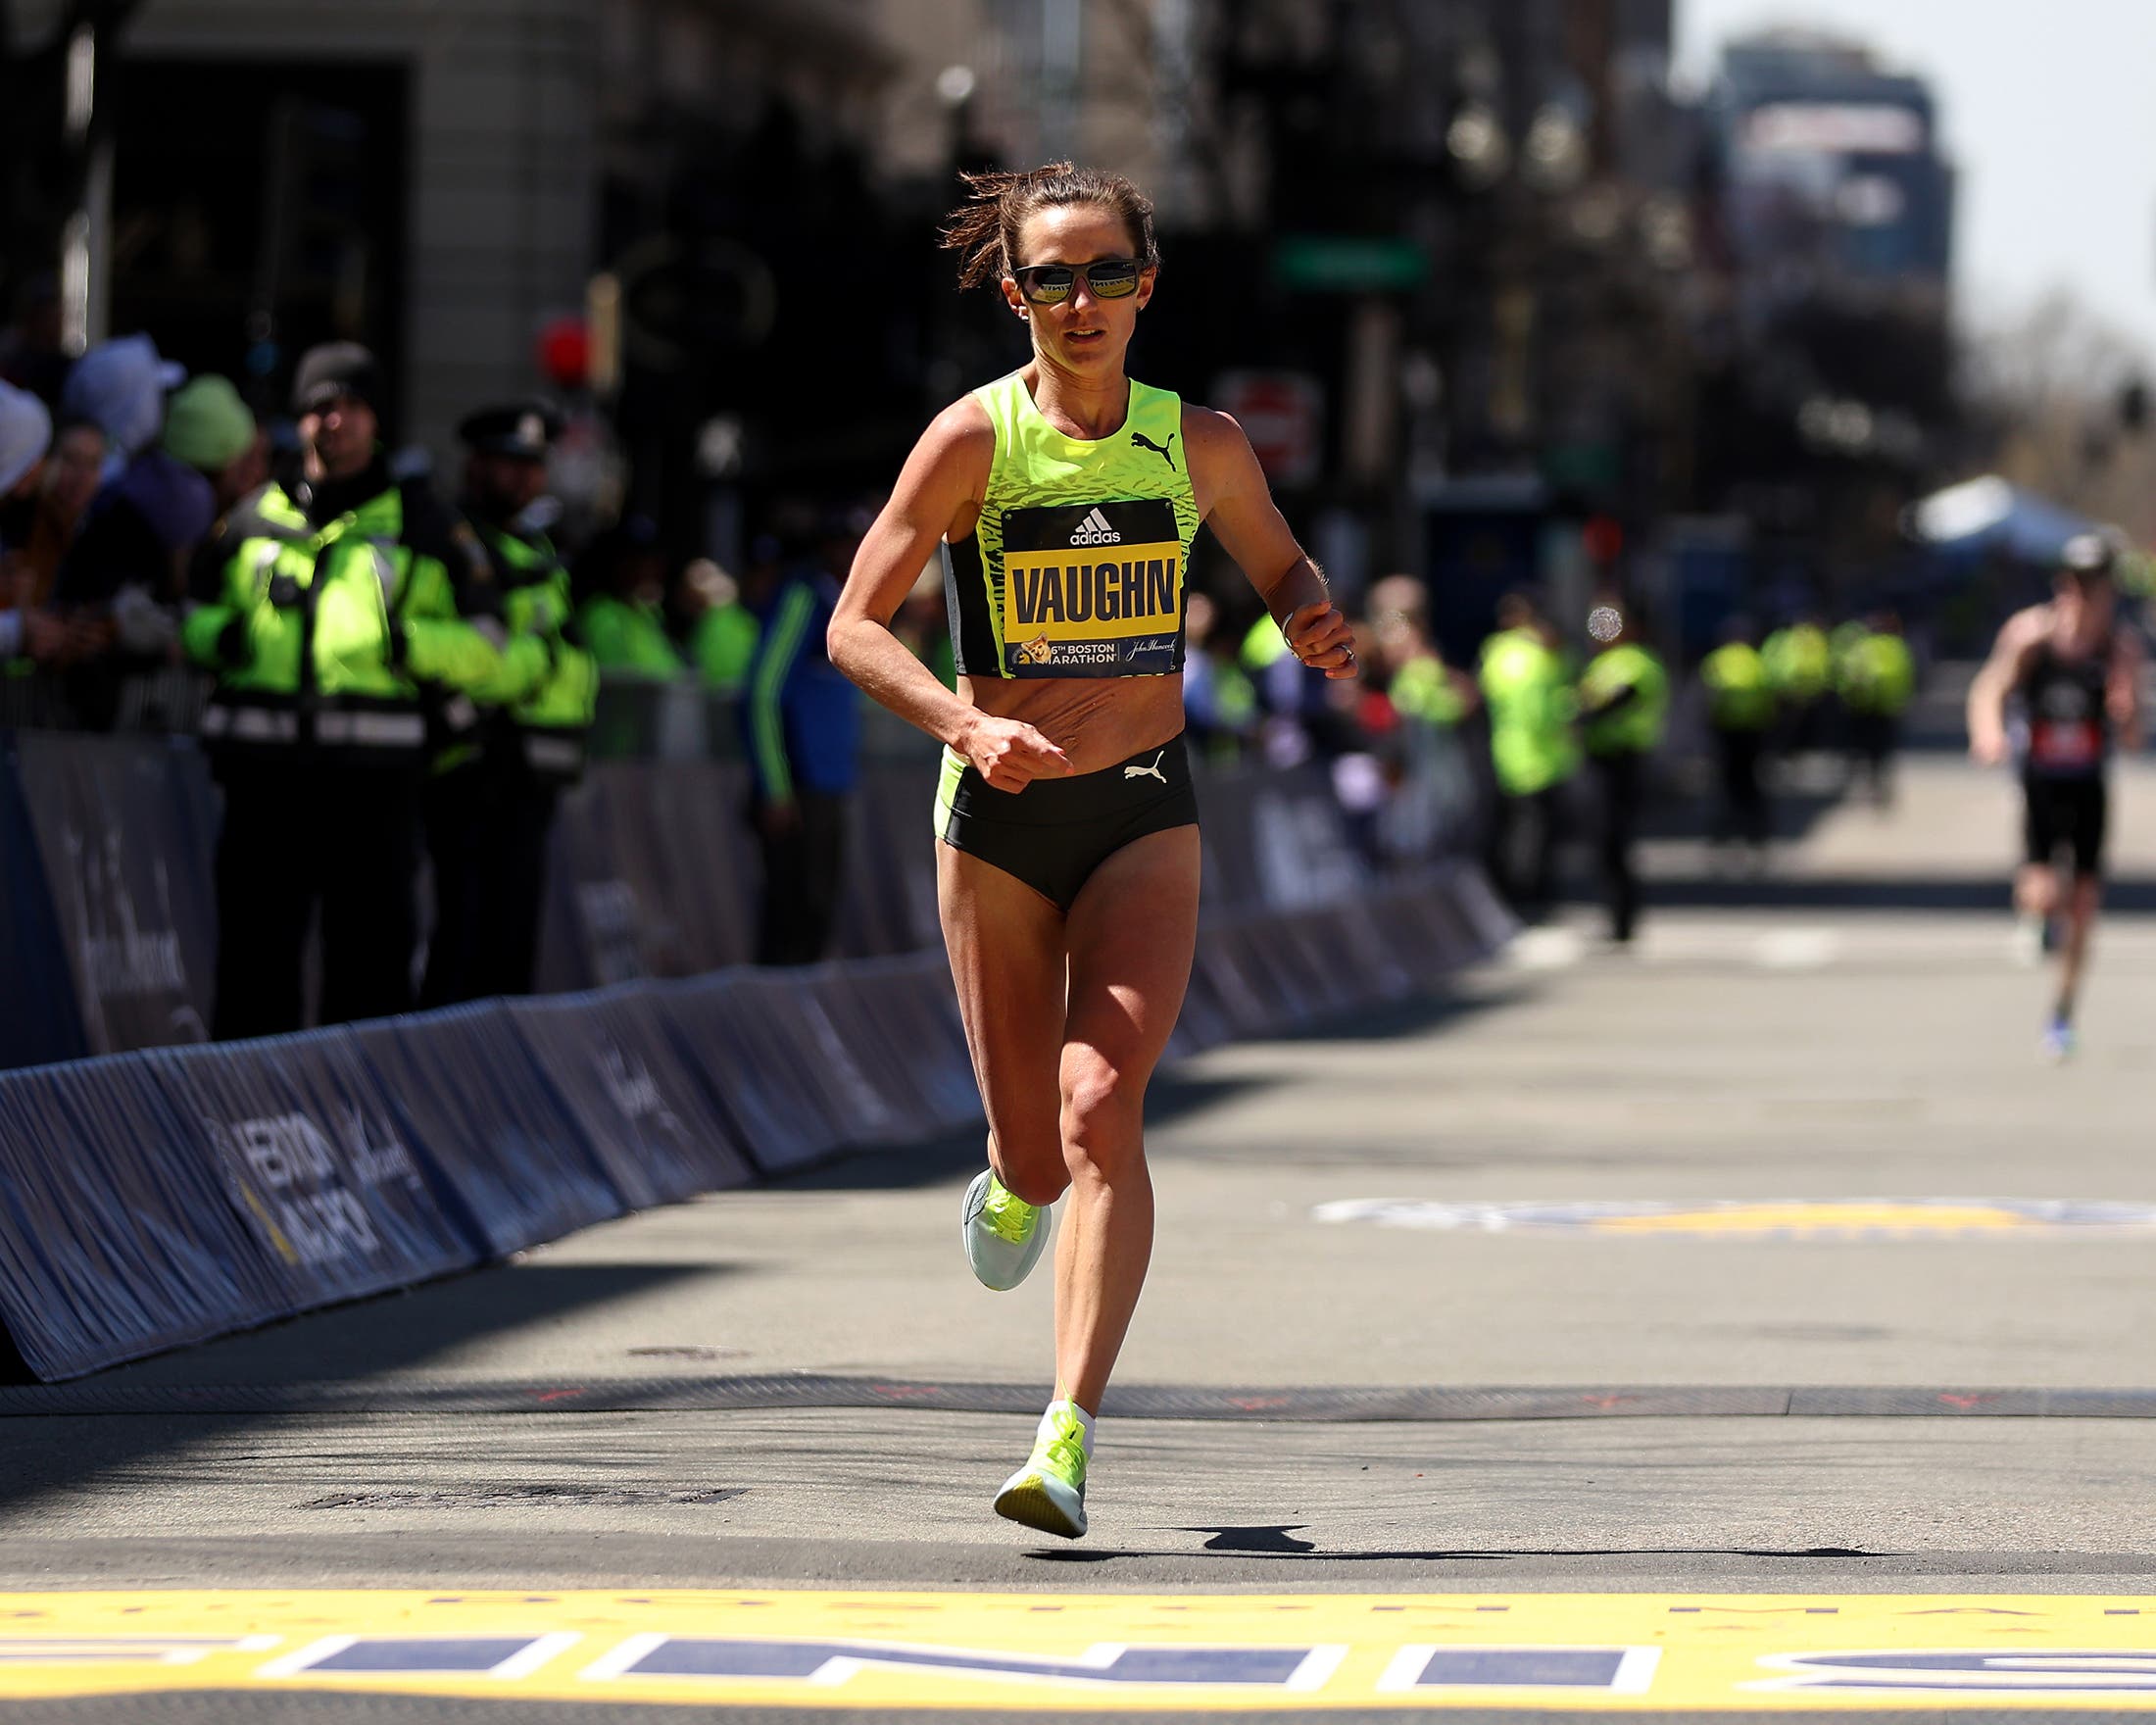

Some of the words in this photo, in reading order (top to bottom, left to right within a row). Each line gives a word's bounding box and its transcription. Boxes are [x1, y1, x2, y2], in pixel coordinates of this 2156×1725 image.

[1070, 530, 1121, 546] adidas
[1012, 559, 1176, 624] VAUGHN
[1068, 643, 1115, 654] BOSTON
